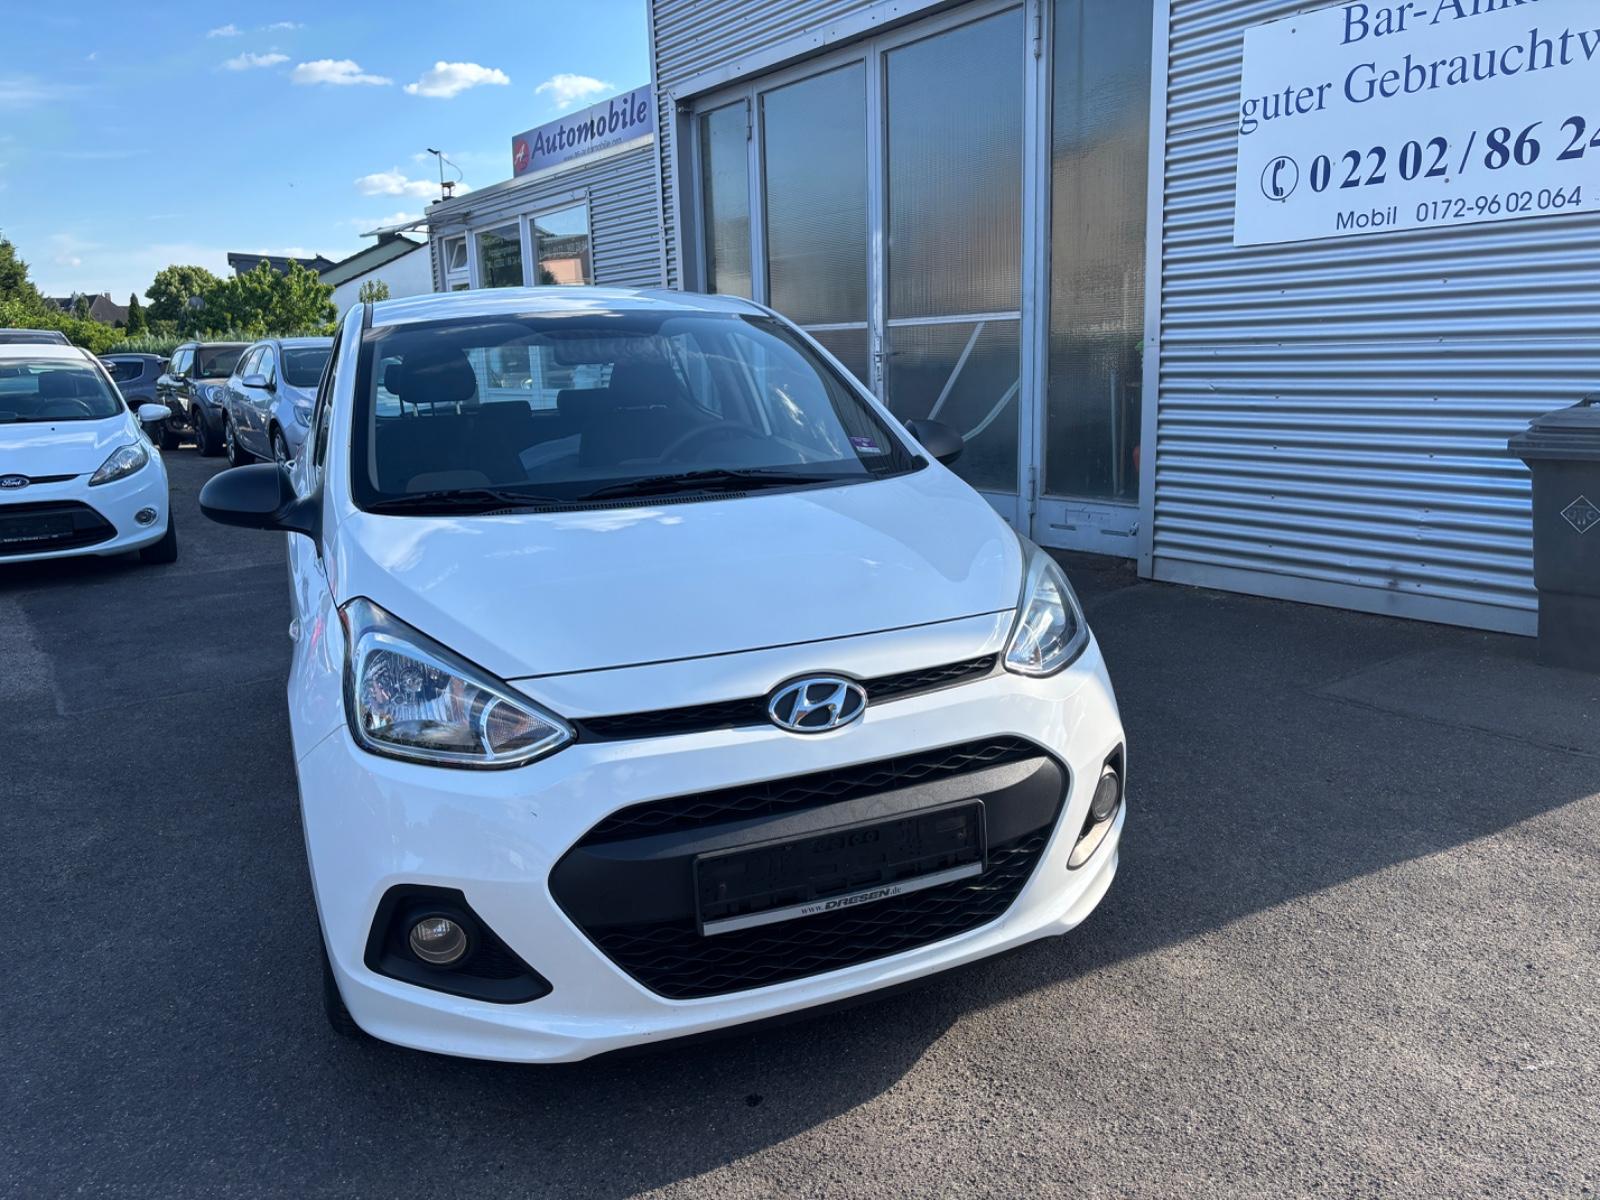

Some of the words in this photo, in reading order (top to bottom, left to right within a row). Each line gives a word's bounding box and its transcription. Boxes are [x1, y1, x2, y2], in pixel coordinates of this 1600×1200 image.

[531, 92, 648, 160] Automobile
[1239, 82, 1333, 136] guter
[1336, 206, 1398, 231] Mobil
